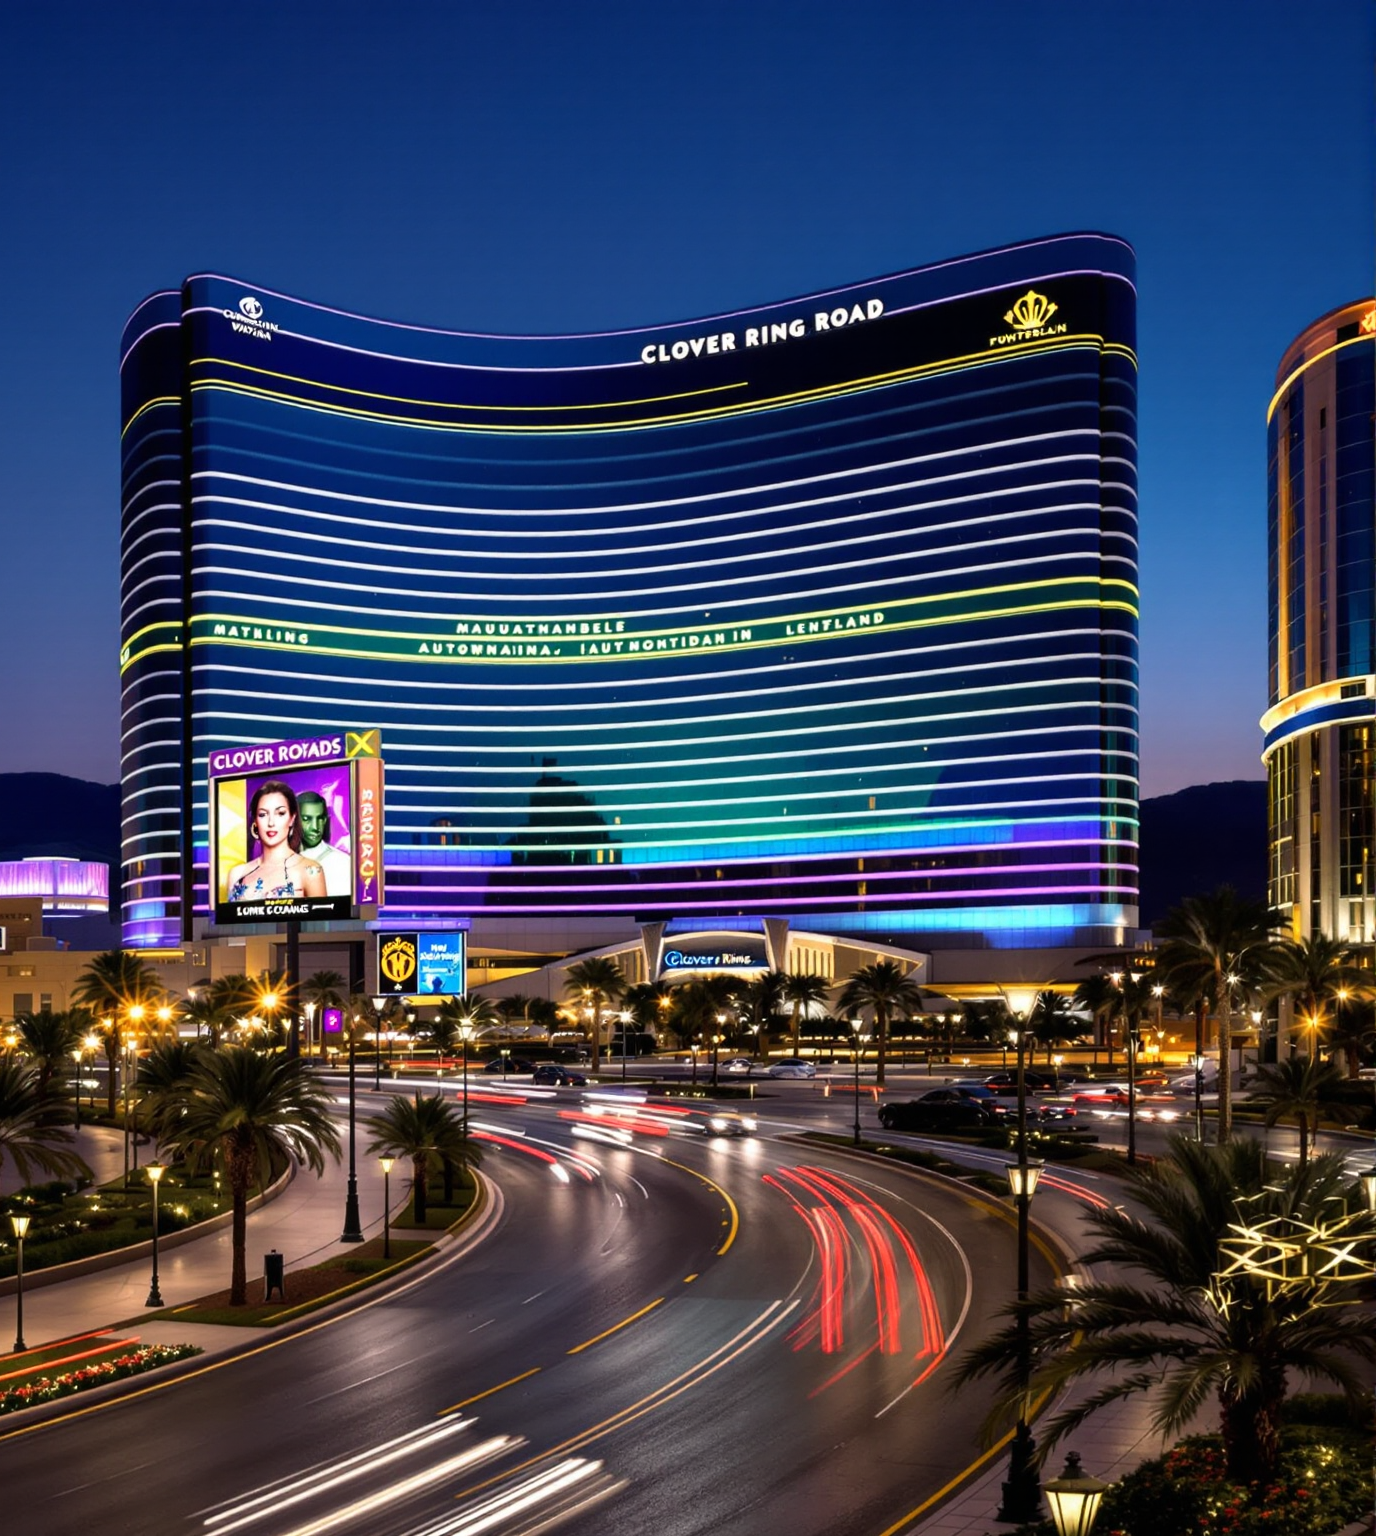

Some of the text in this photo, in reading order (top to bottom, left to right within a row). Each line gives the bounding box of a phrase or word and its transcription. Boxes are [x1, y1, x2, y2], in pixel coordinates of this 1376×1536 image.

[641, 298, 885, 364] CLOVER RING ROAD
[213, 748, 275, 770] CLOVER
